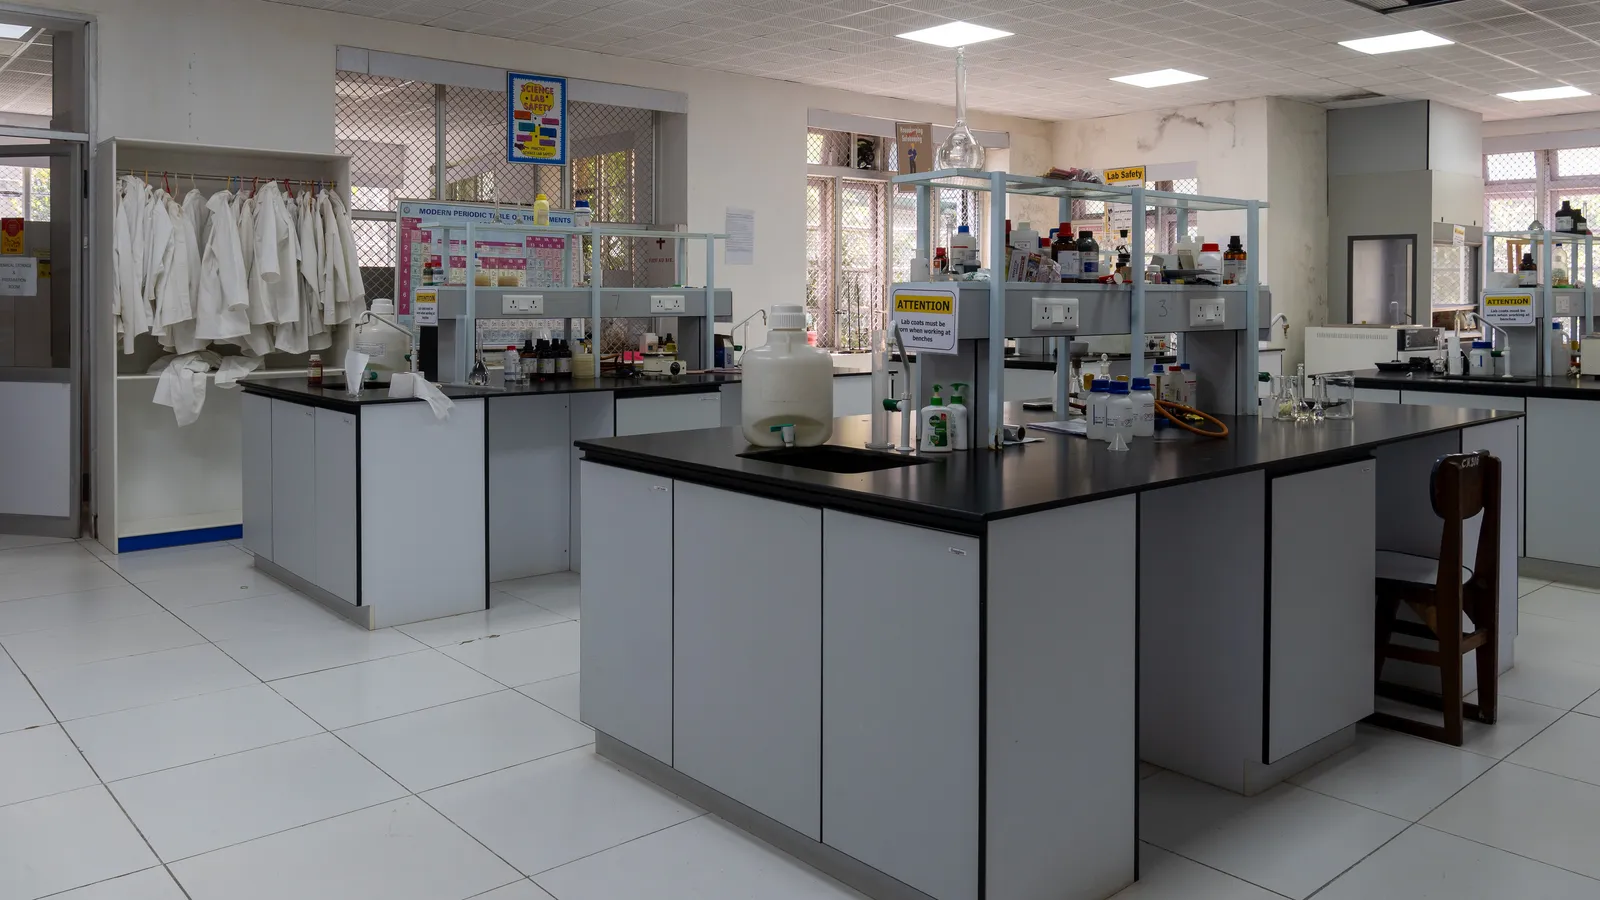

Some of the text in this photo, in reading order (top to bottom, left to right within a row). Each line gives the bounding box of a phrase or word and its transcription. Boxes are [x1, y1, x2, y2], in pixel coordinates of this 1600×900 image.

[520, 84, 554, 95] SCIENCE
[530, 94, 544, 103] LAB
[523, 103, 552, 111] SAFETY
[1121, 170, 1142, 178] Safety
[898, 300, 950, 311] ATTENTION
[1158, 300, 1168, 317] 3
